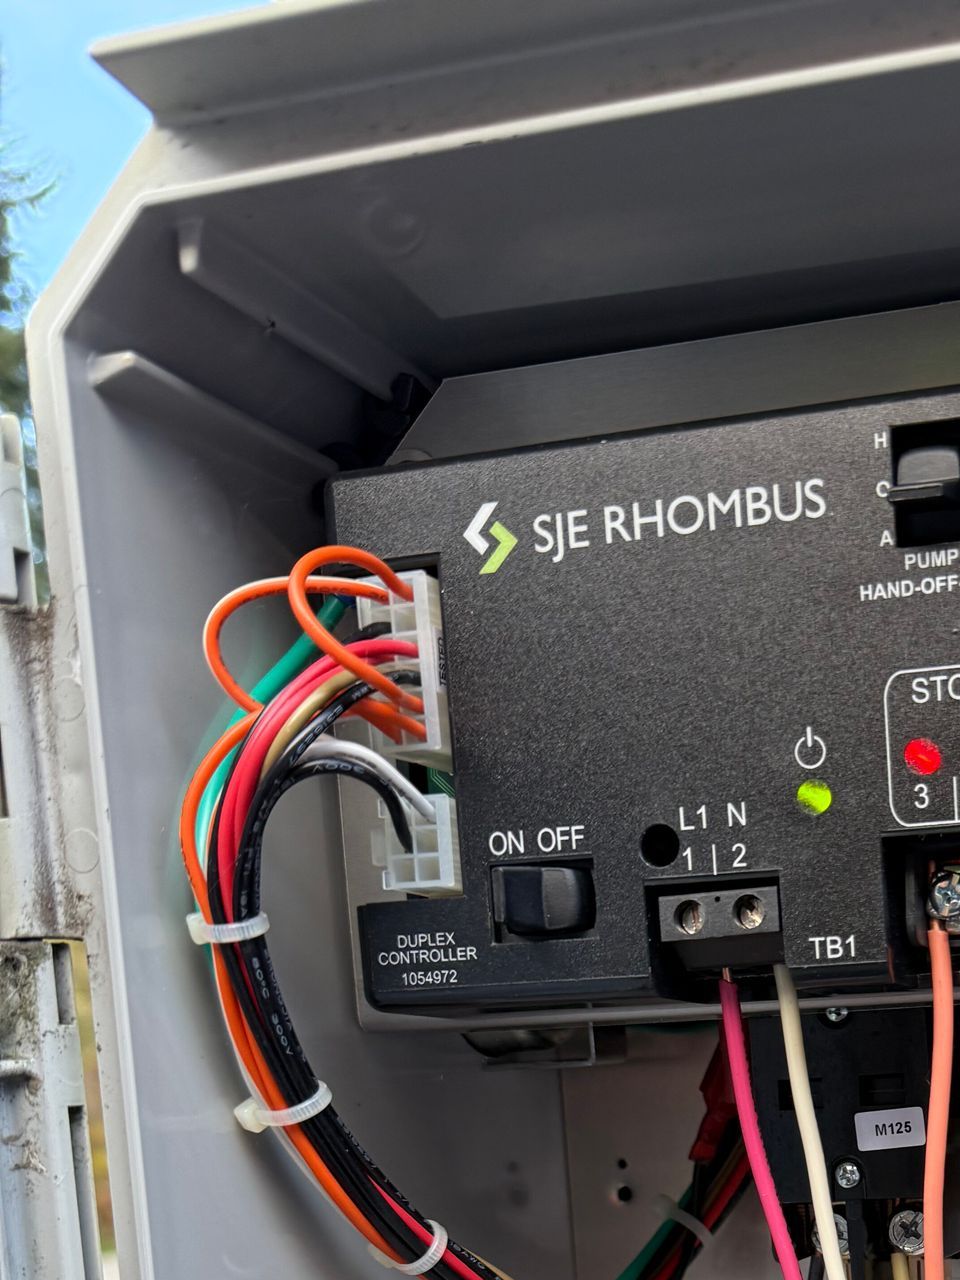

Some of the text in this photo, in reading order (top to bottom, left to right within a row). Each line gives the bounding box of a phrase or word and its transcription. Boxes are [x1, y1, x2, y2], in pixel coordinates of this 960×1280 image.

[873, 432, 888, 449] H
[532, 477, 828, 563] SJE RHOMBUS
[879, 529, 895, 548] A
[904, 550, 959, 571] PUMP
[913, 784, 929, 809] 3
[678, 801, 748, 831] L1 N
[488, 825, 587, 857] ON OFF
[681, 843, 748, 871] 1 2
[396, 931, 457, 950] DUPLEX
[808, 936, 858, 961] TB1
[377, 945, 479, 966] CONTROLLER
[400, 969, 459, 987] 1054972
[875, 1120, 912, 1137] M125
